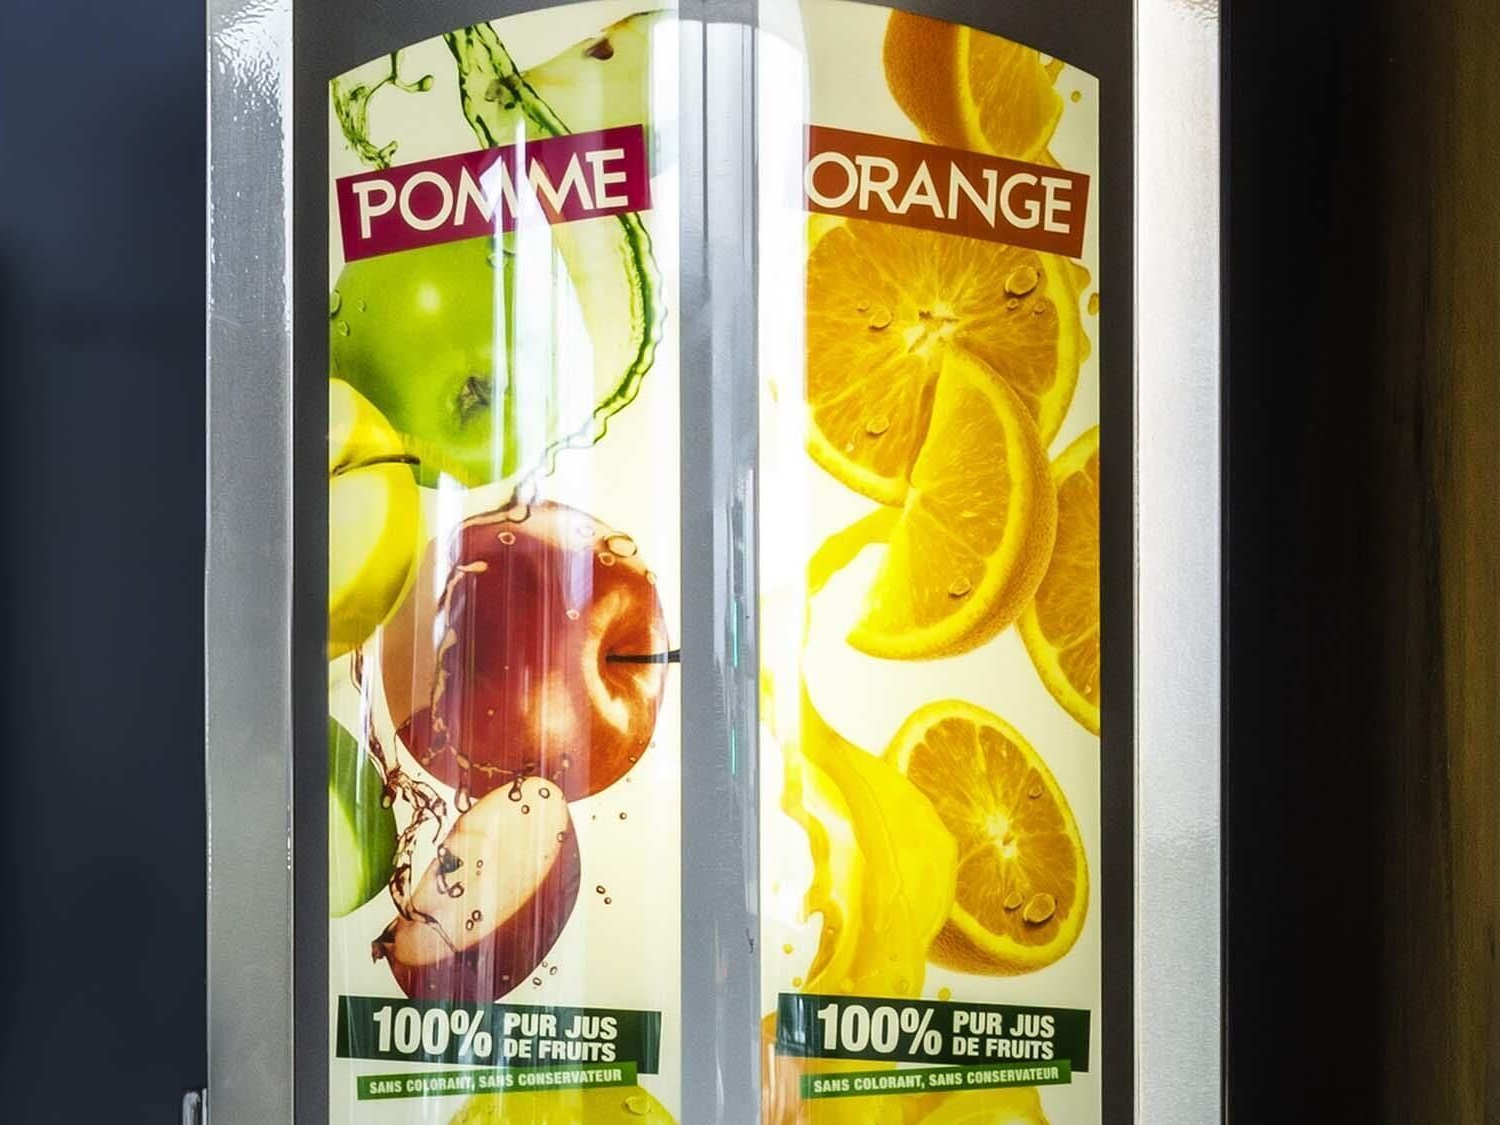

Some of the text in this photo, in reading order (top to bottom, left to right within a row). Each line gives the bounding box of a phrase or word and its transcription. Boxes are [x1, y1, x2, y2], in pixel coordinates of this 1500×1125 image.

[351, 147, 629, 240] POMME
[803, 150, 1074, 235] ORANGE
[372, 1005, 618, 1059] 100% PUR JUS
[817, 1003, 1056, 1056] 100% PUR JUS
[952, 1036, 1054, 1060] DE FRUITS
[503, 1038, 617, 1063] DE FRUITS
[369, 1080, 402, 1094] SANS
[478, 1074, 514, 1089] SANS
[518, 1068, 622, 1086] CONSERVATEUR
[813, 1066, 1059, 1094] SANS COLORANT, SANS CONSERVATEUR
